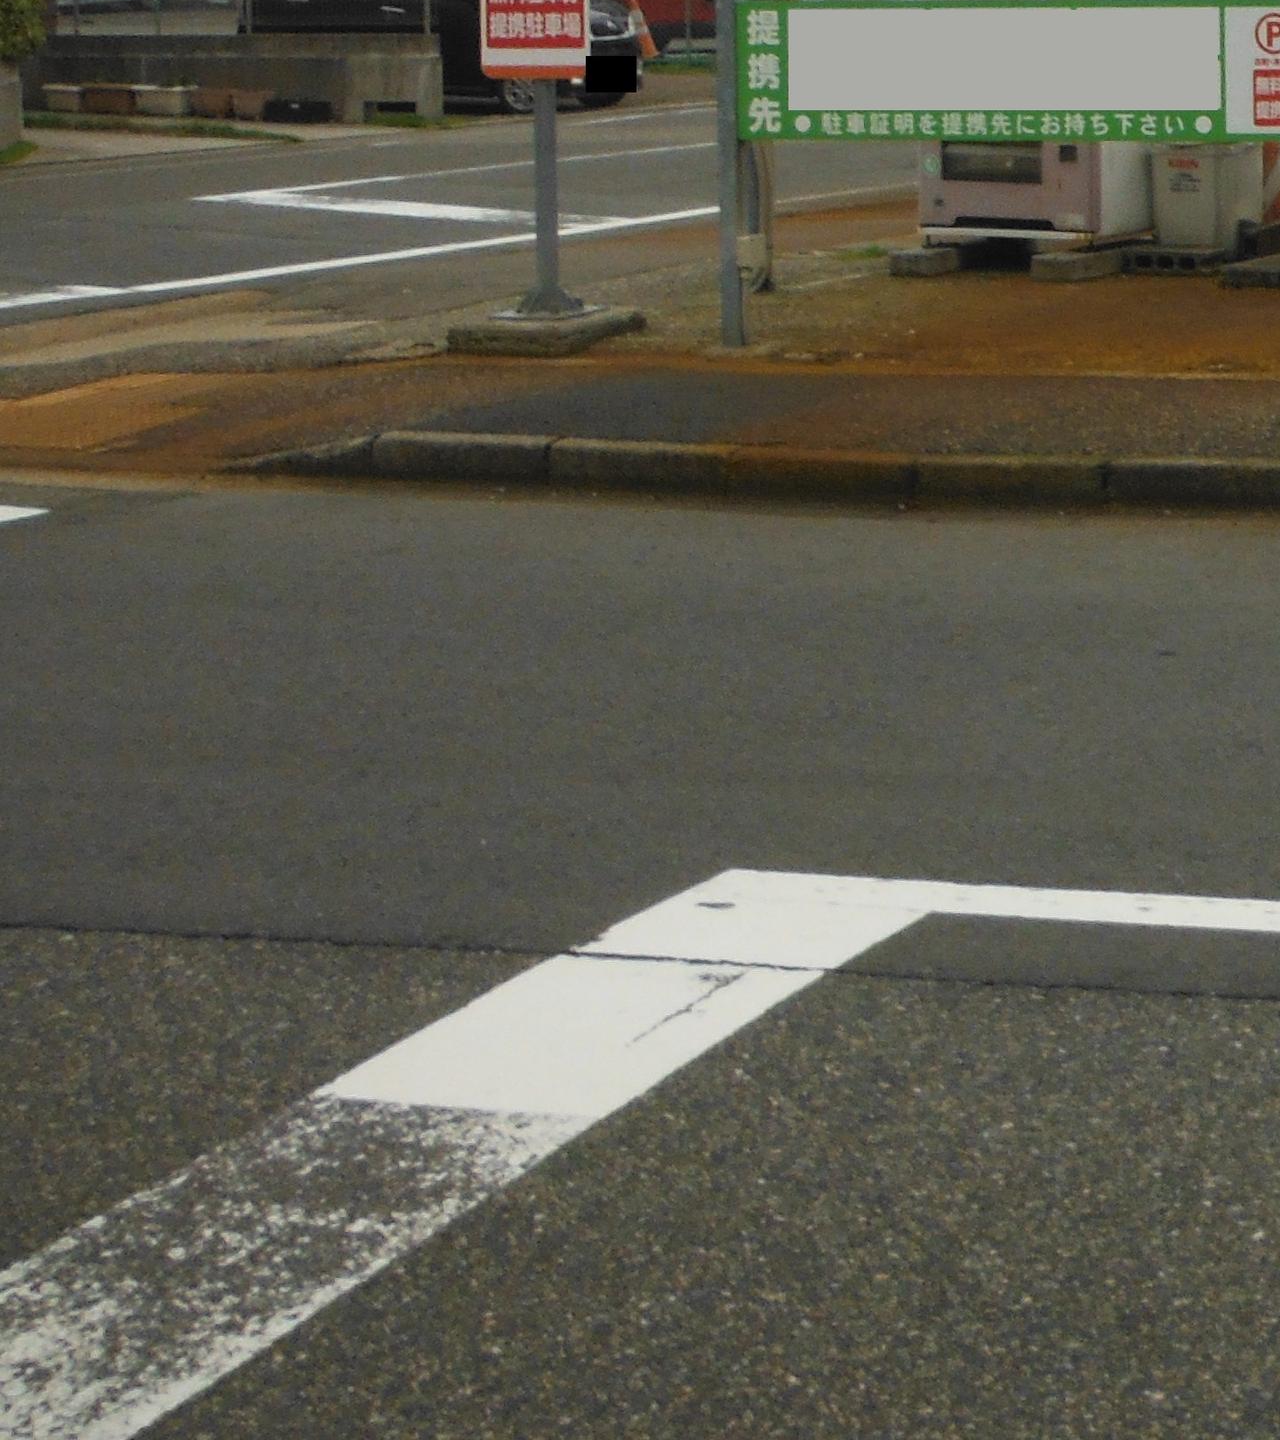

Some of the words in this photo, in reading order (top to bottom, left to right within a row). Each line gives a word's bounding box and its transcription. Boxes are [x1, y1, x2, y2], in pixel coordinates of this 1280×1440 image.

[747, 9, 782, 134] 提携先
[821, 112, 1185, 137] 駐車証明を提携先にお持ち下さい
